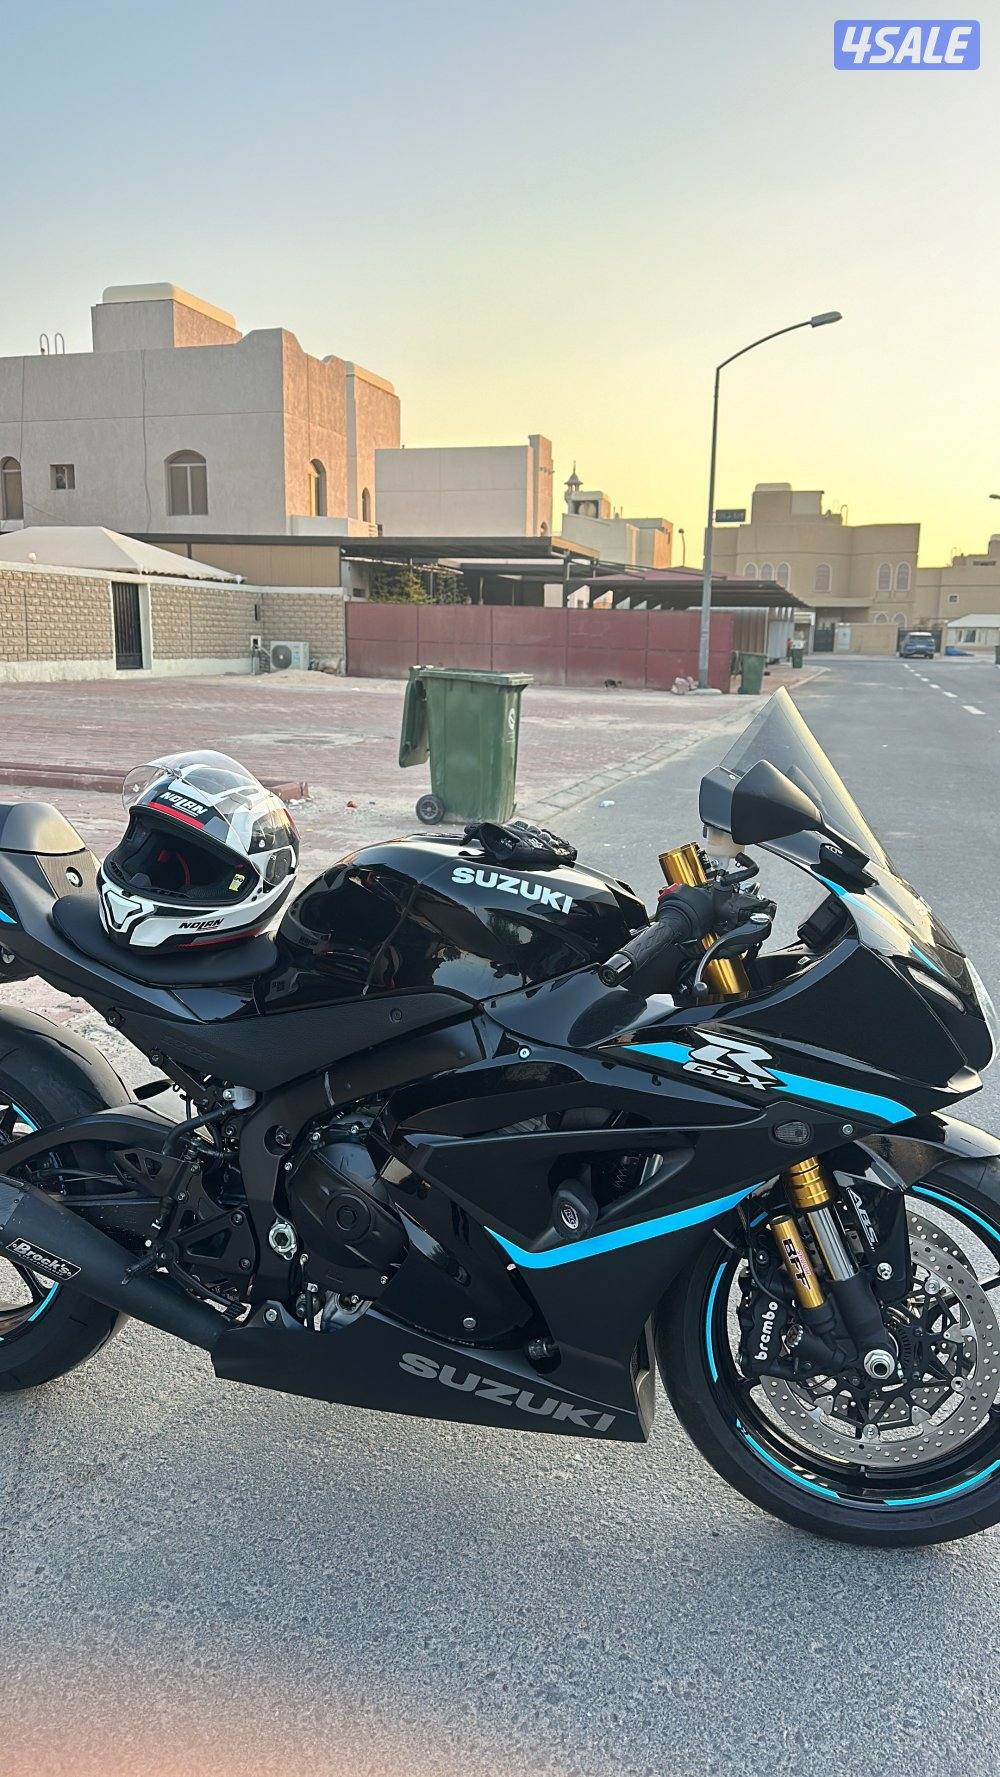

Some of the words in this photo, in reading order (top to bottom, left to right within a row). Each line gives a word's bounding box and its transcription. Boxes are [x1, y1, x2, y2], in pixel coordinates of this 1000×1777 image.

[160, 791, 208, 815] NOLAN
[451, 867, 574, 915] SUZUKI
[179, 918, 225, 931] NOLAN
[683, 1061, 777, 1091] GSX
[846, 1187, 879, 1244] ABS
[14, 1242, 70, 1274] Brock's
[754, 1301, 778, 1360] brembo
[399, 1352, 616, 1432] SUZUKI
